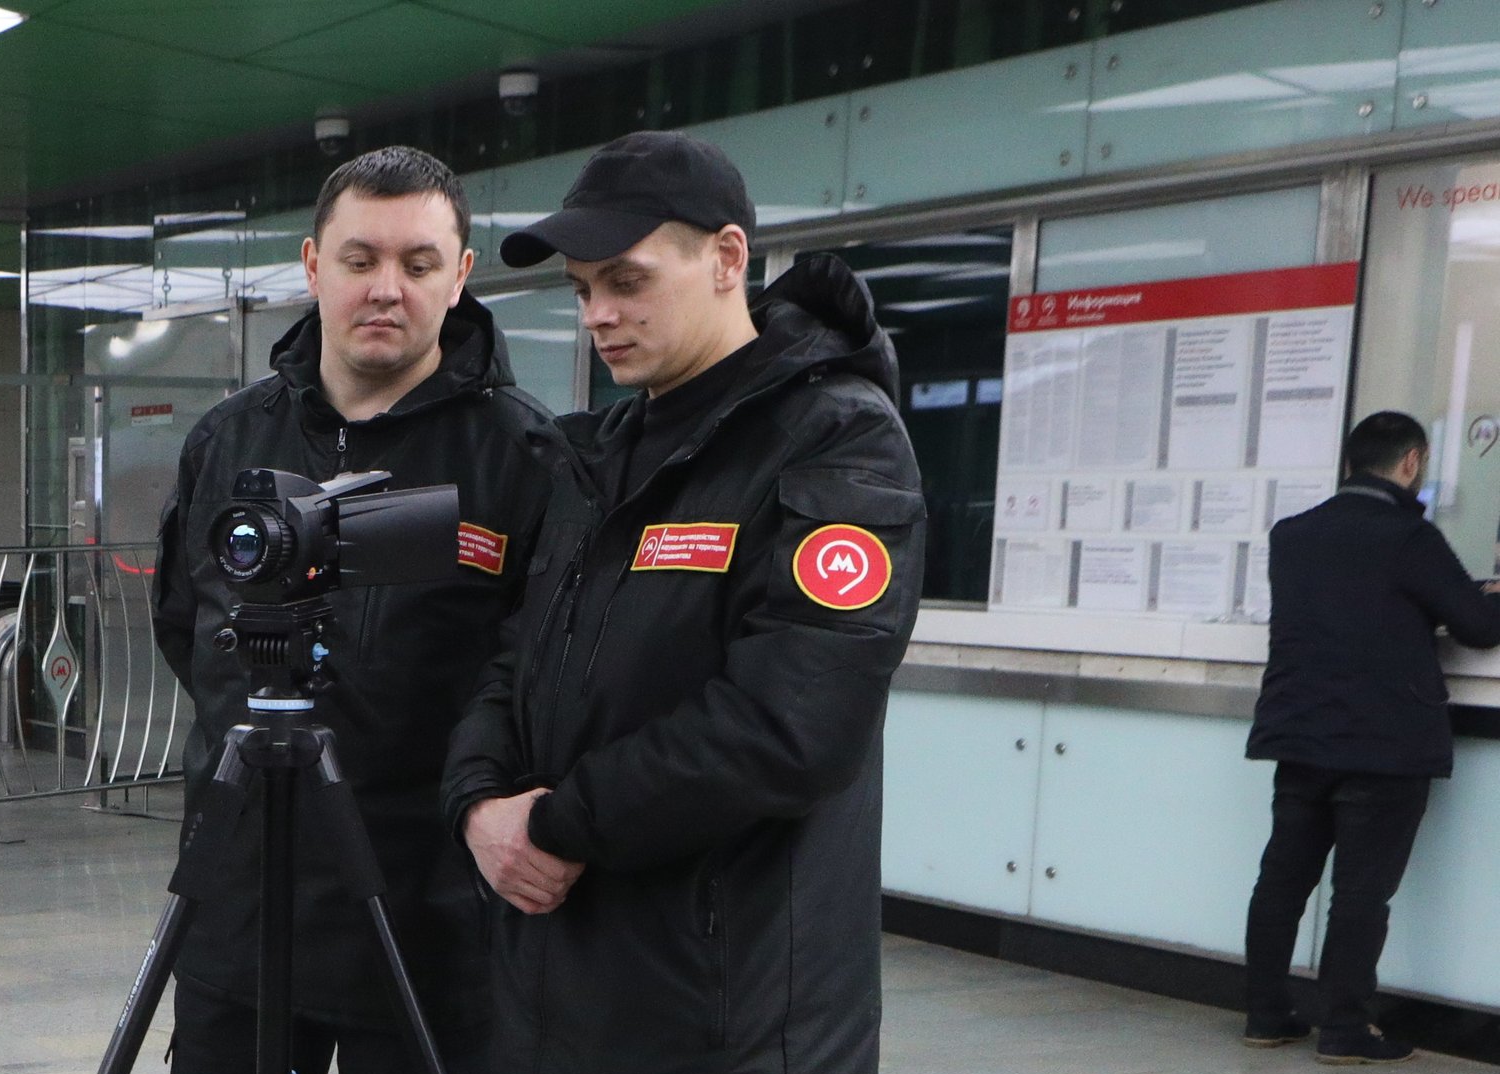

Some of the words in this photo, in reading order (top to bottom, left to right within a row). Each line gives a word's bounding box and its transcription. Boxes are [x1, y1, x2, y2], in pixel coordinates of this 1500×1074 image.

[1397, 184, 1434, 209] We
[1443, 182, 1500, 212] spea
[1066, 292, 1142, 312] Информация
